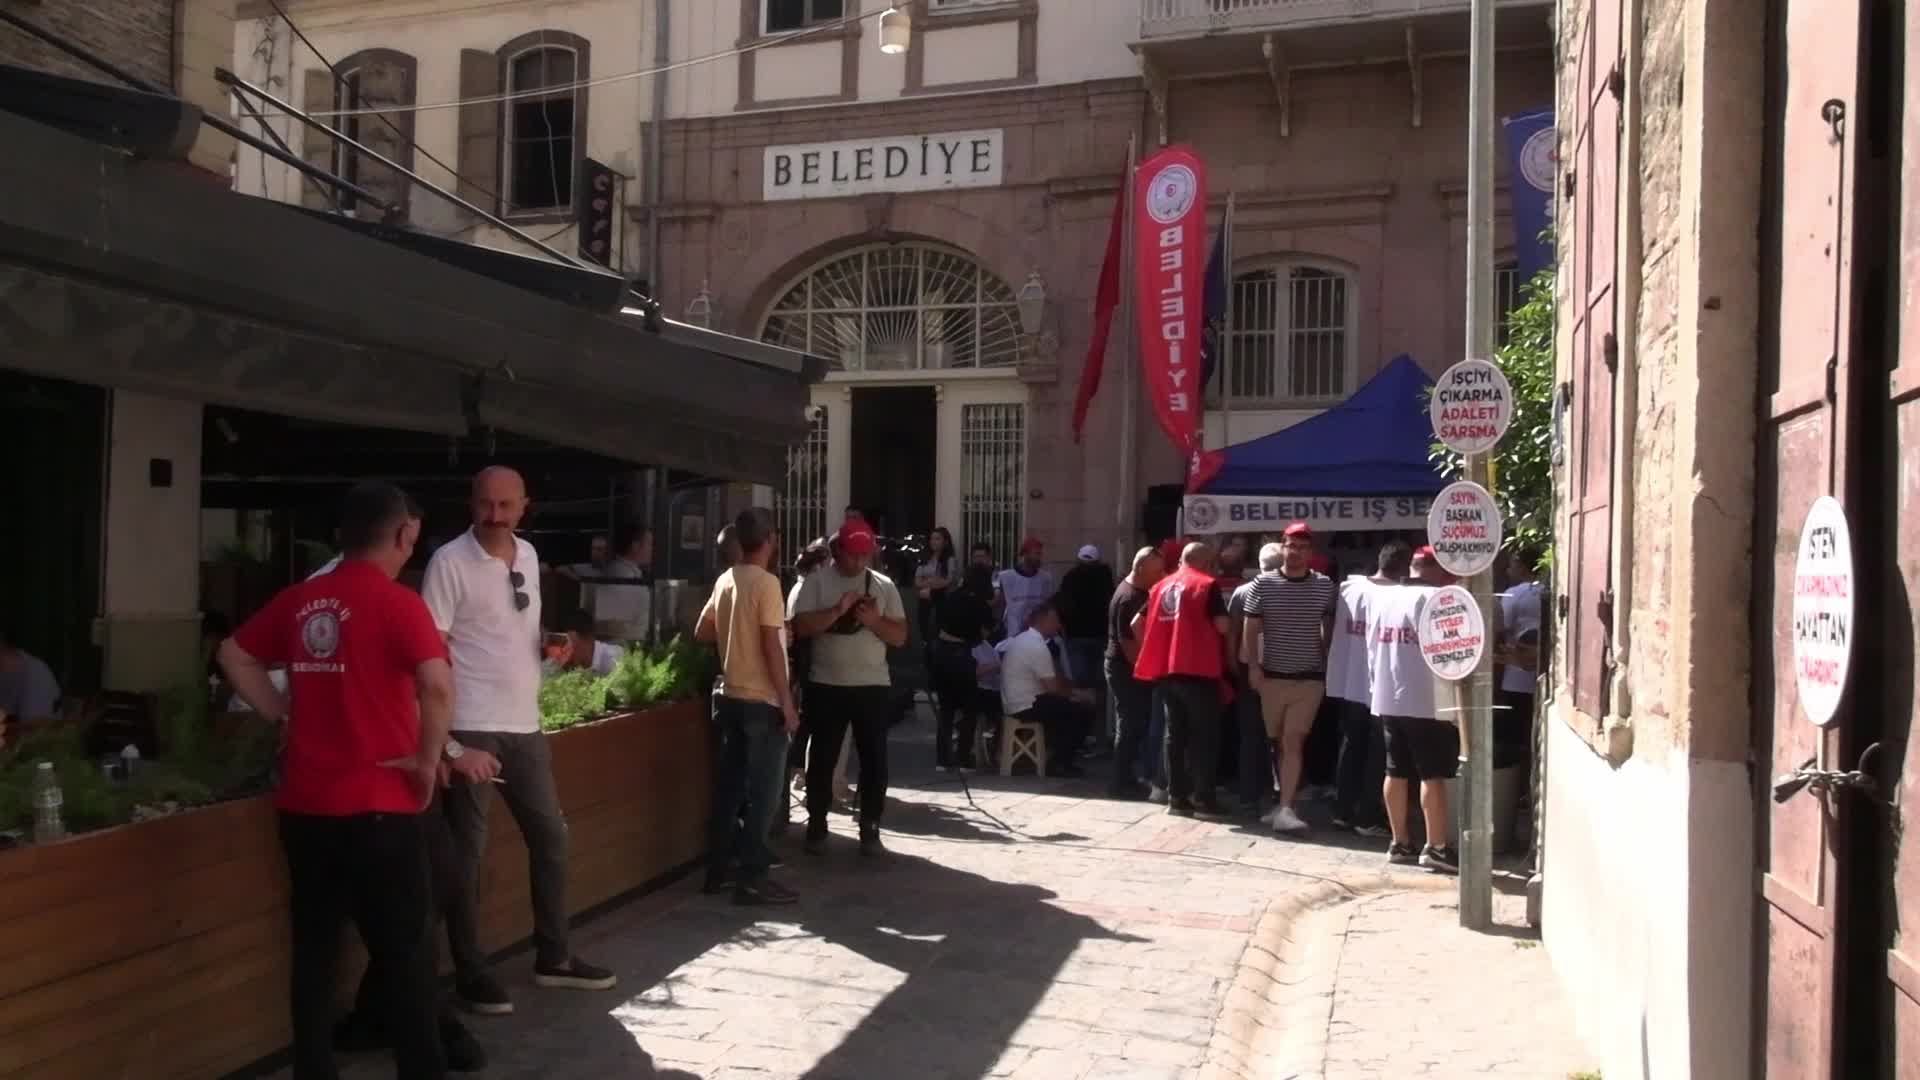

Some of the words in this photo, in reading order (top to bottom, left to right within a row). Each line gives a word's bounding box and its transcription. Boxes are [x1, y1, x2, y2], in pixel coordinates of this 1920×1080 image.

[773, 137, 991, 186] BELEDİYE
[1440, 389, 1503, 405] ÇIKARMA
[1230, 498, 1353, 521] BELEDİYE
